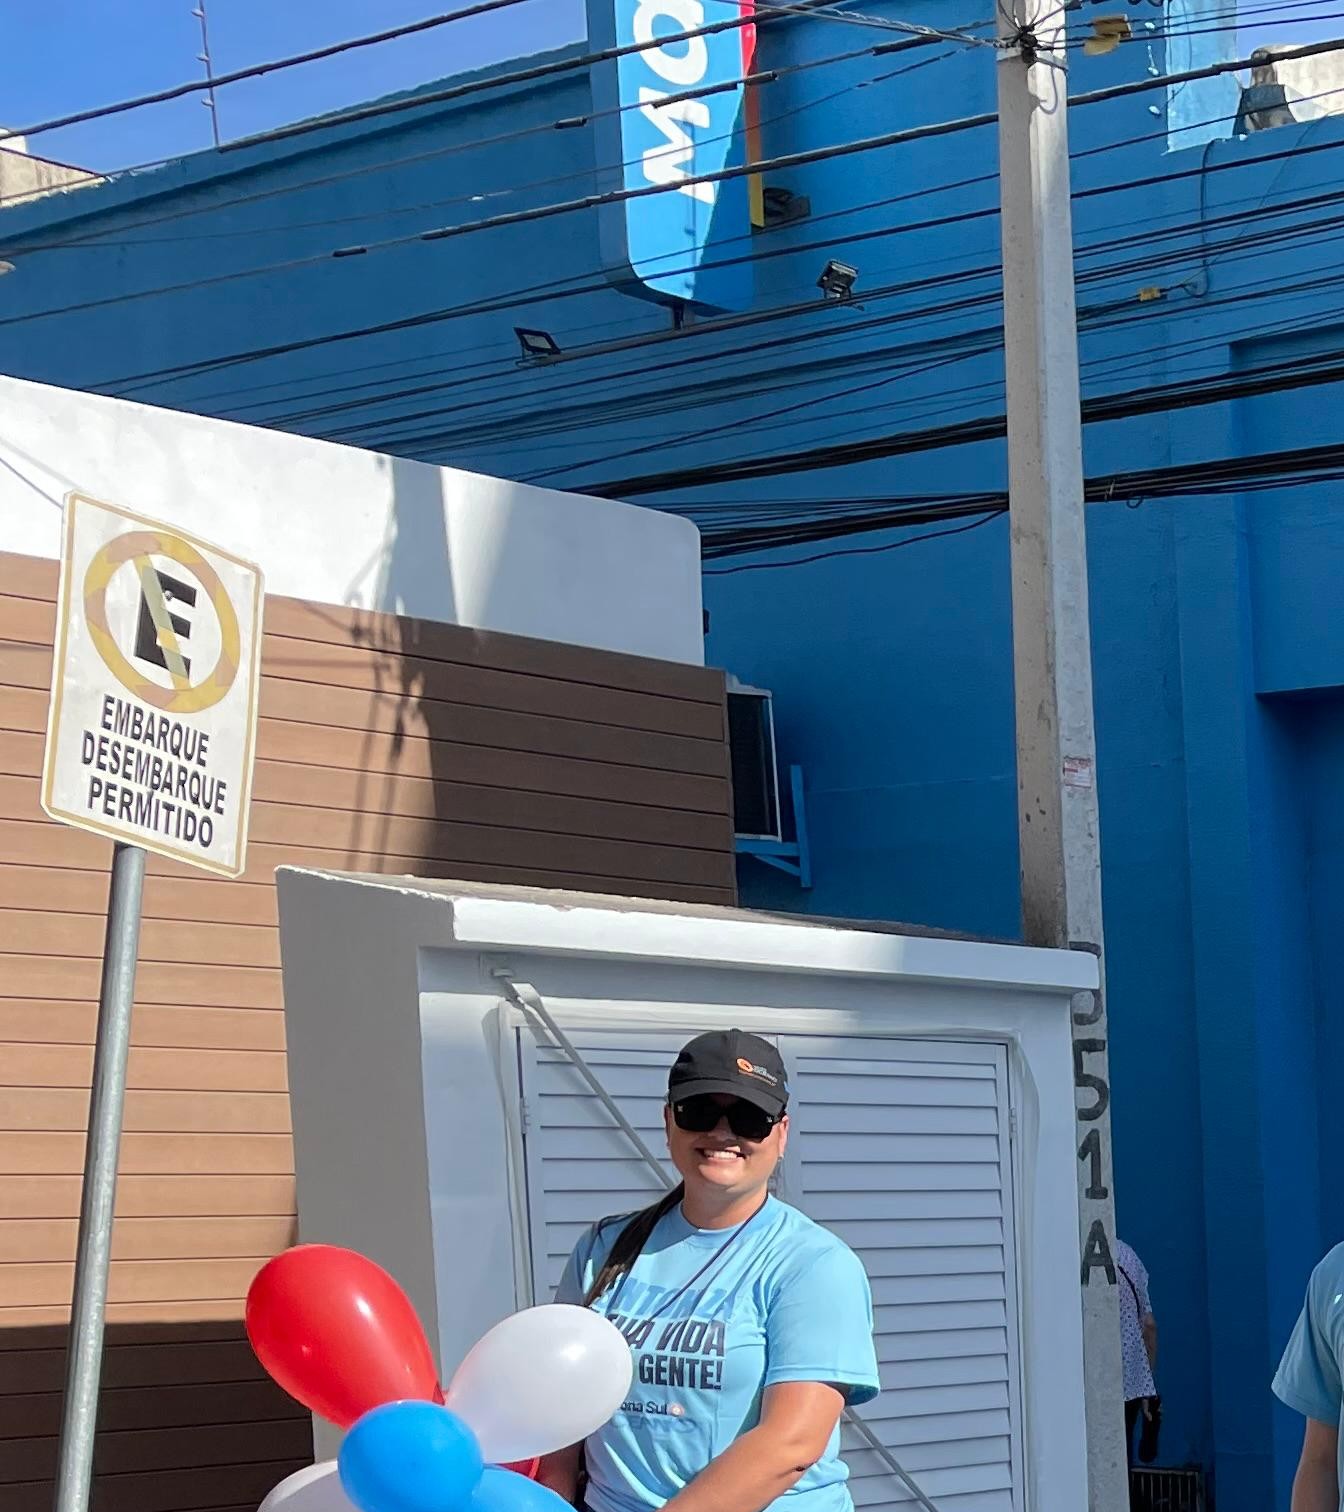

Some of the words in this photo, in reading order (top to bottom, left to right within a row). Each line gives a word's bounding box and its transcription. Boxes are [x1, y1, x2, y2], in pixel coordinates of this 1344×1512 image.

[101, 693, 210, 767] EMBARQUE
[81, 729, 227, 815] DESEMBARQUE
[87, 775, 213, 847] PERMITIDO
[638, 1353, 723, 1390] GENTE!
